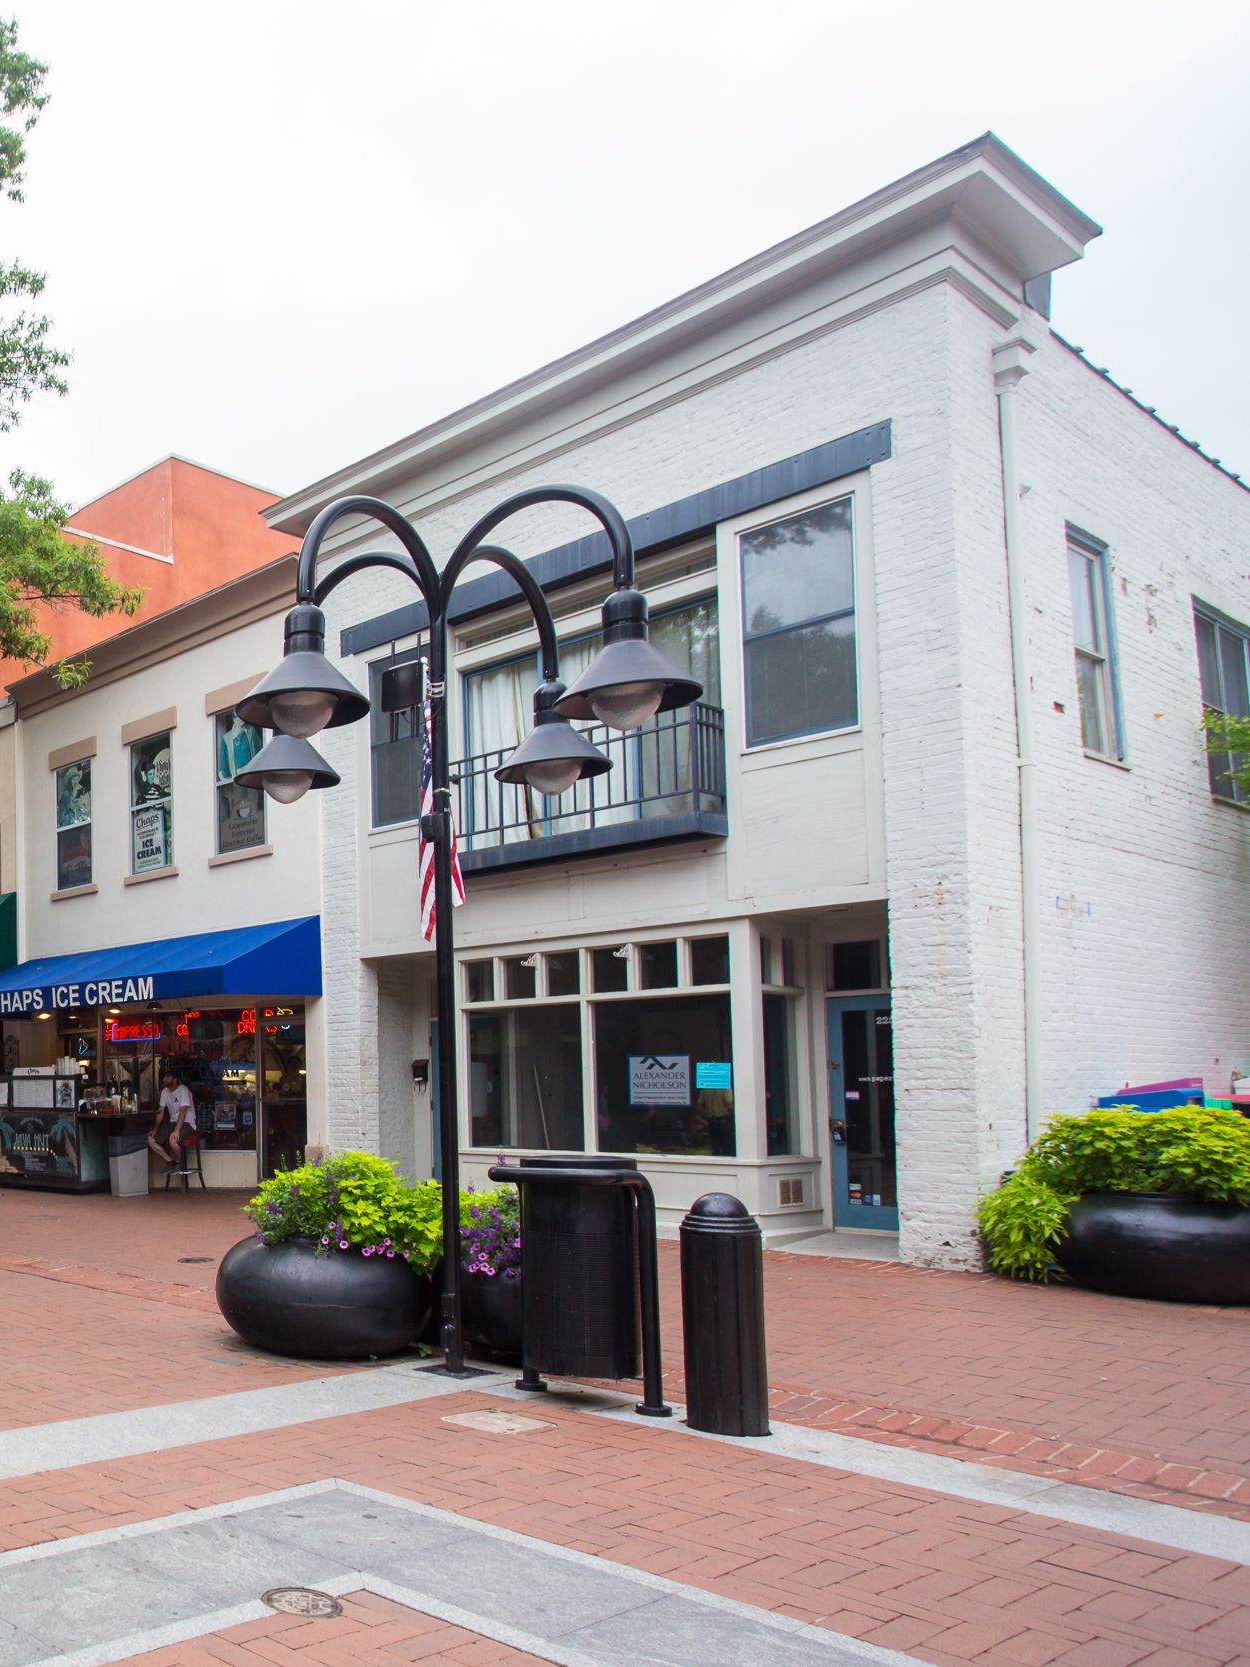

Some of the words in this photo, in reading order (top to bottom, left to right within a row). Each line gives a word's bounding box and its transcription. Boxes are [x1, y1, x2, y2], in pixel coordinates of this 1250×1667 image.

[136, 813, 160, 829] Chaps
[228, 818, 259, 830] Cappuccino
[232, 828, 255, 838] Espresso
[142, 838, 154, 849] ICE
[222, 838, 245, 848] Gourmet
[136, 845, 162, 860] CREAM
[52, 984, 81, 1009] ICE
[85, 976, 154, 1006] CREAM
[633, 1071, 686, 1080] ALEXANDER
[632, 1081, 687, 1089] NICHOLSON
[13, 1133, 32, 1146] JAVA
[33, 1133, 50, 1147] HUT
